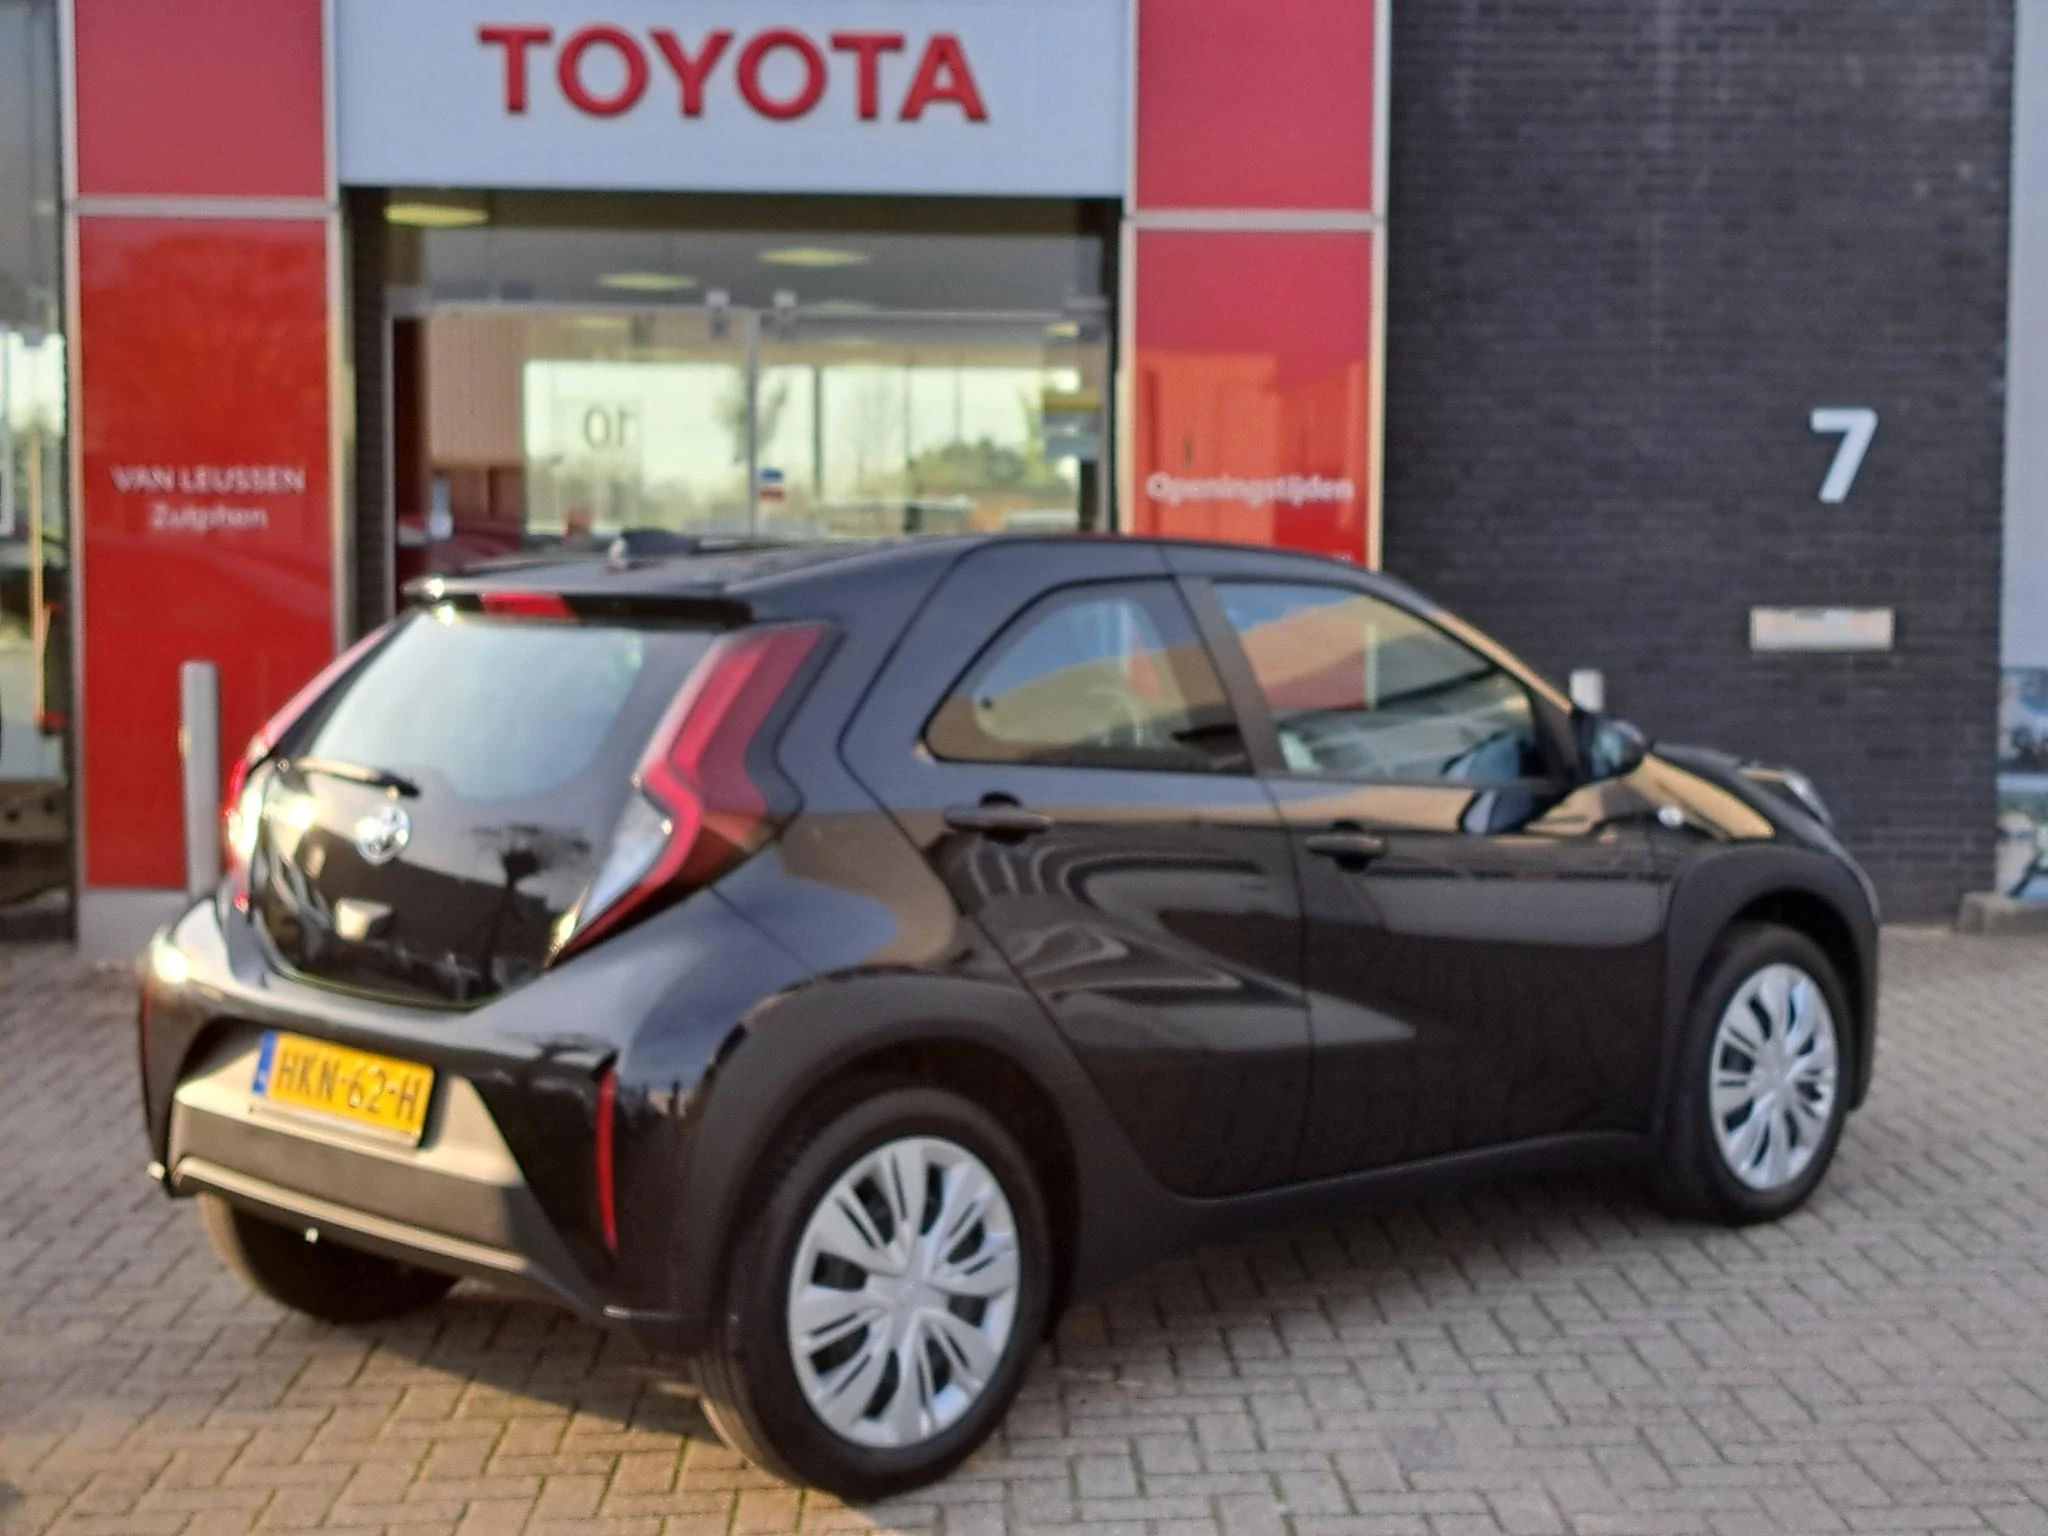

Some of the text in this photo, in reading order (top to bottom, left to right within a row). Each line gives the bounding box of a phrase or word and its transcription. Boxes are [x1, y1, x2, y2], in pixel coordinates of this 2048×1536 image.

[478, 24, 990, 123] TOYOTA
[110, 464, 174, 495] VAN
[1810, 407, 1878, 503] 7
[151, 501, 269, 534] Zutphen
[1146, 471, 1355, 508] Openingstijden
[275, 1048, 424, 1124] HKN-62-H
